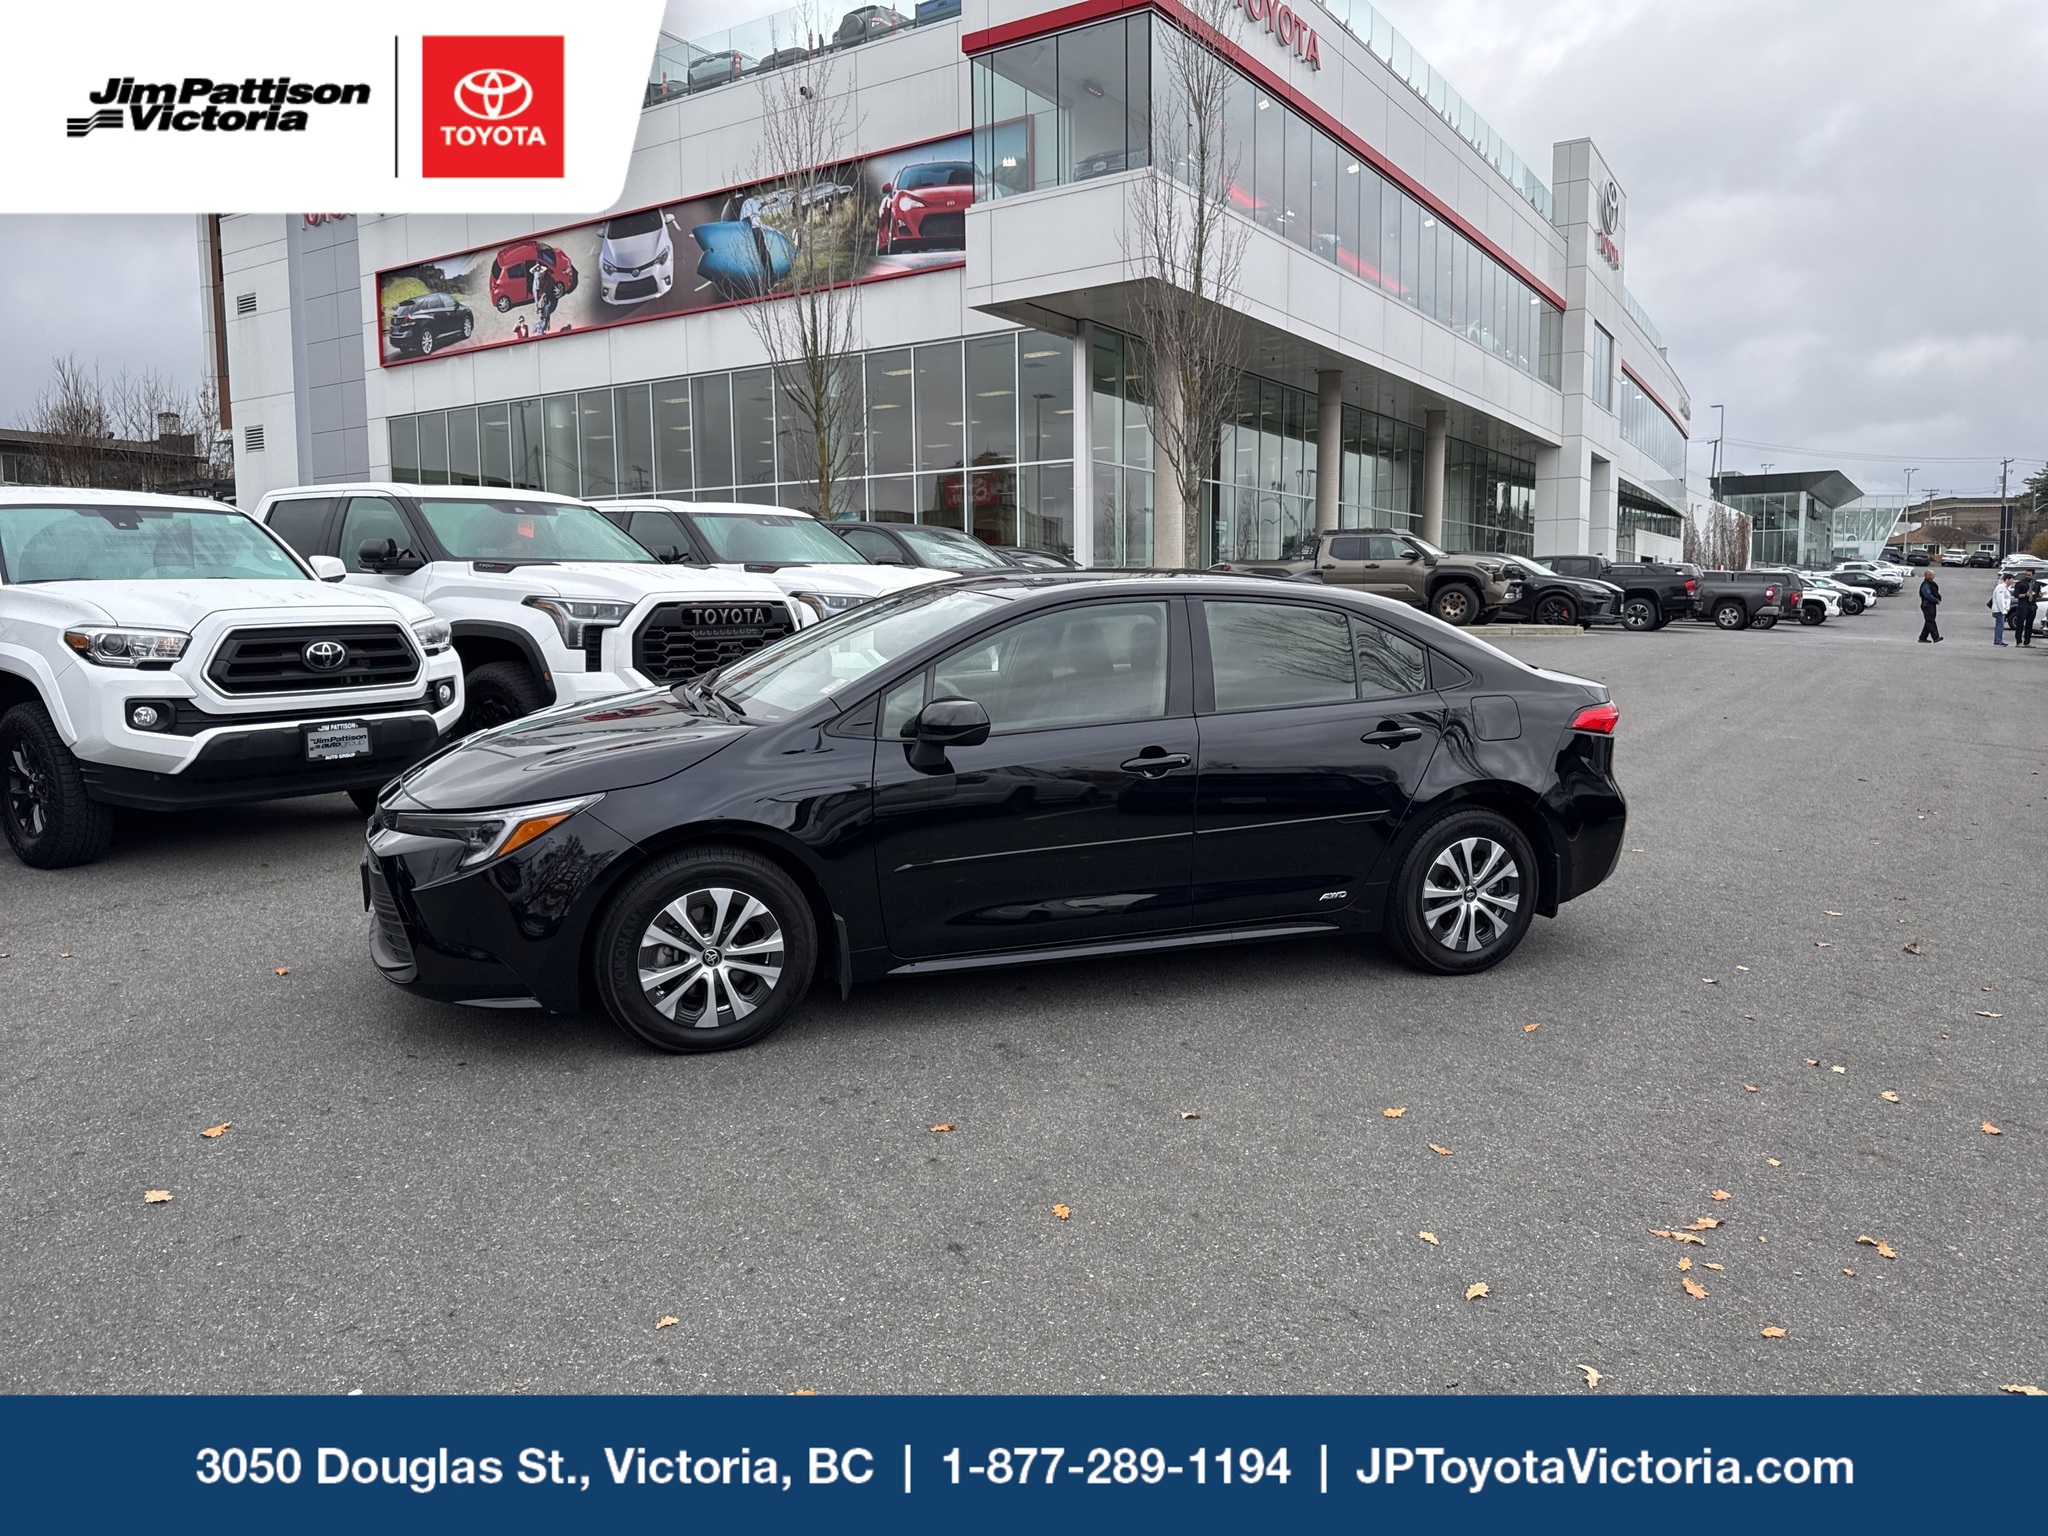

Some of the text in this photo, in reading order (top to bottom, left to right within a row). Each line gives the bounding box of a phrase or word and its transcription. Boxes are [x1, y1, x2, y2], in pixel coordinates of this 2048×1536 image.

[1233, 0, 1321, 71] OYOTA
[692, 608, 765, 625] TOYOTA
[330, 722, 356, 730] PATTISON
[1319, 890, 1347, 901] AWD
